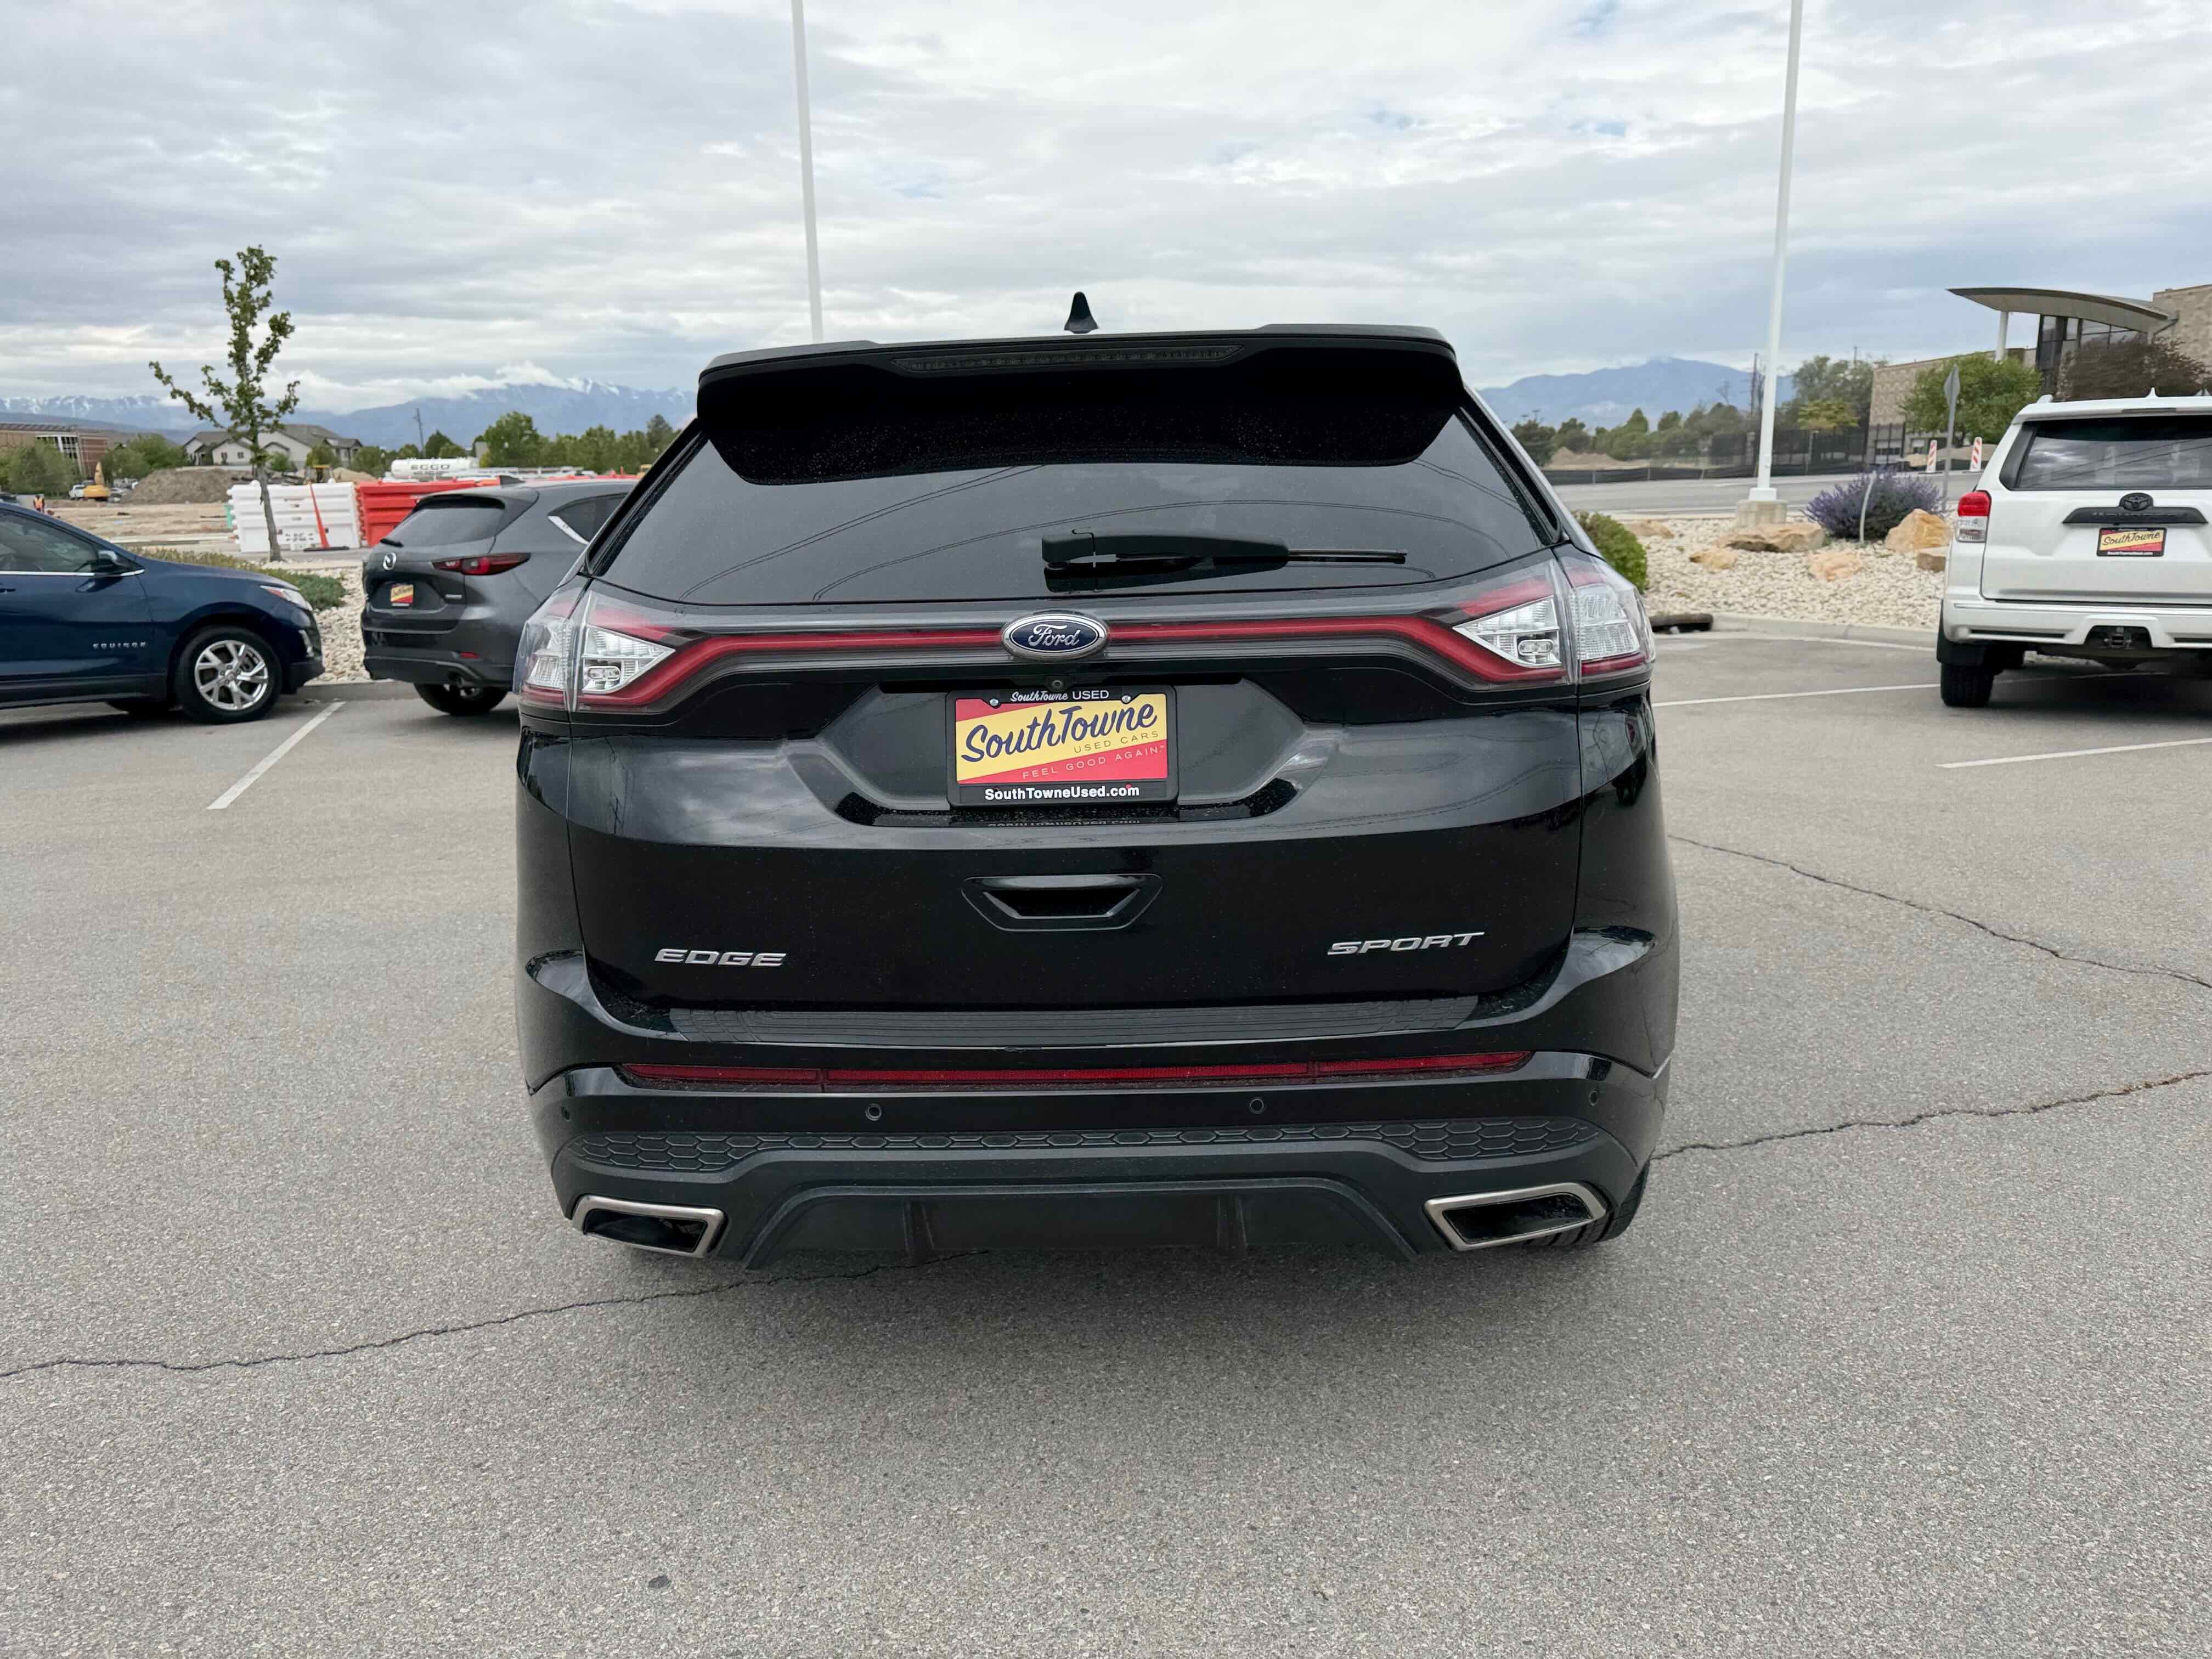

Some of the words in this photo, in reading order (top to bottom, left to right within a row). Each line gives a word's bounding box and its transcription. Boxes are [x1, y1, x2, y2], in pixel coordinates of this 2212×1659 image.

[2102, 531, 2160, 545] SouthTowne
[1028, 624, 1081, 646] Ford
[1010, 691, 1068, 702] SouthTowne
[1073, 690, 1109, 699] USED
[961, 703, 1157, 763] SouthTowne
[1074, 740, 1111, 753] USED
[1120, 731, 1159, 744] CARS
[1023, 766, 1058, 780] FEEL
[1065, 757, 1106, 771] GOOD
[985, 785, 1140, 800] SouthTowneUsed.com
[1327, 932, 1485, 955] SPORT
[654, 948, 786, 967] EDGE
